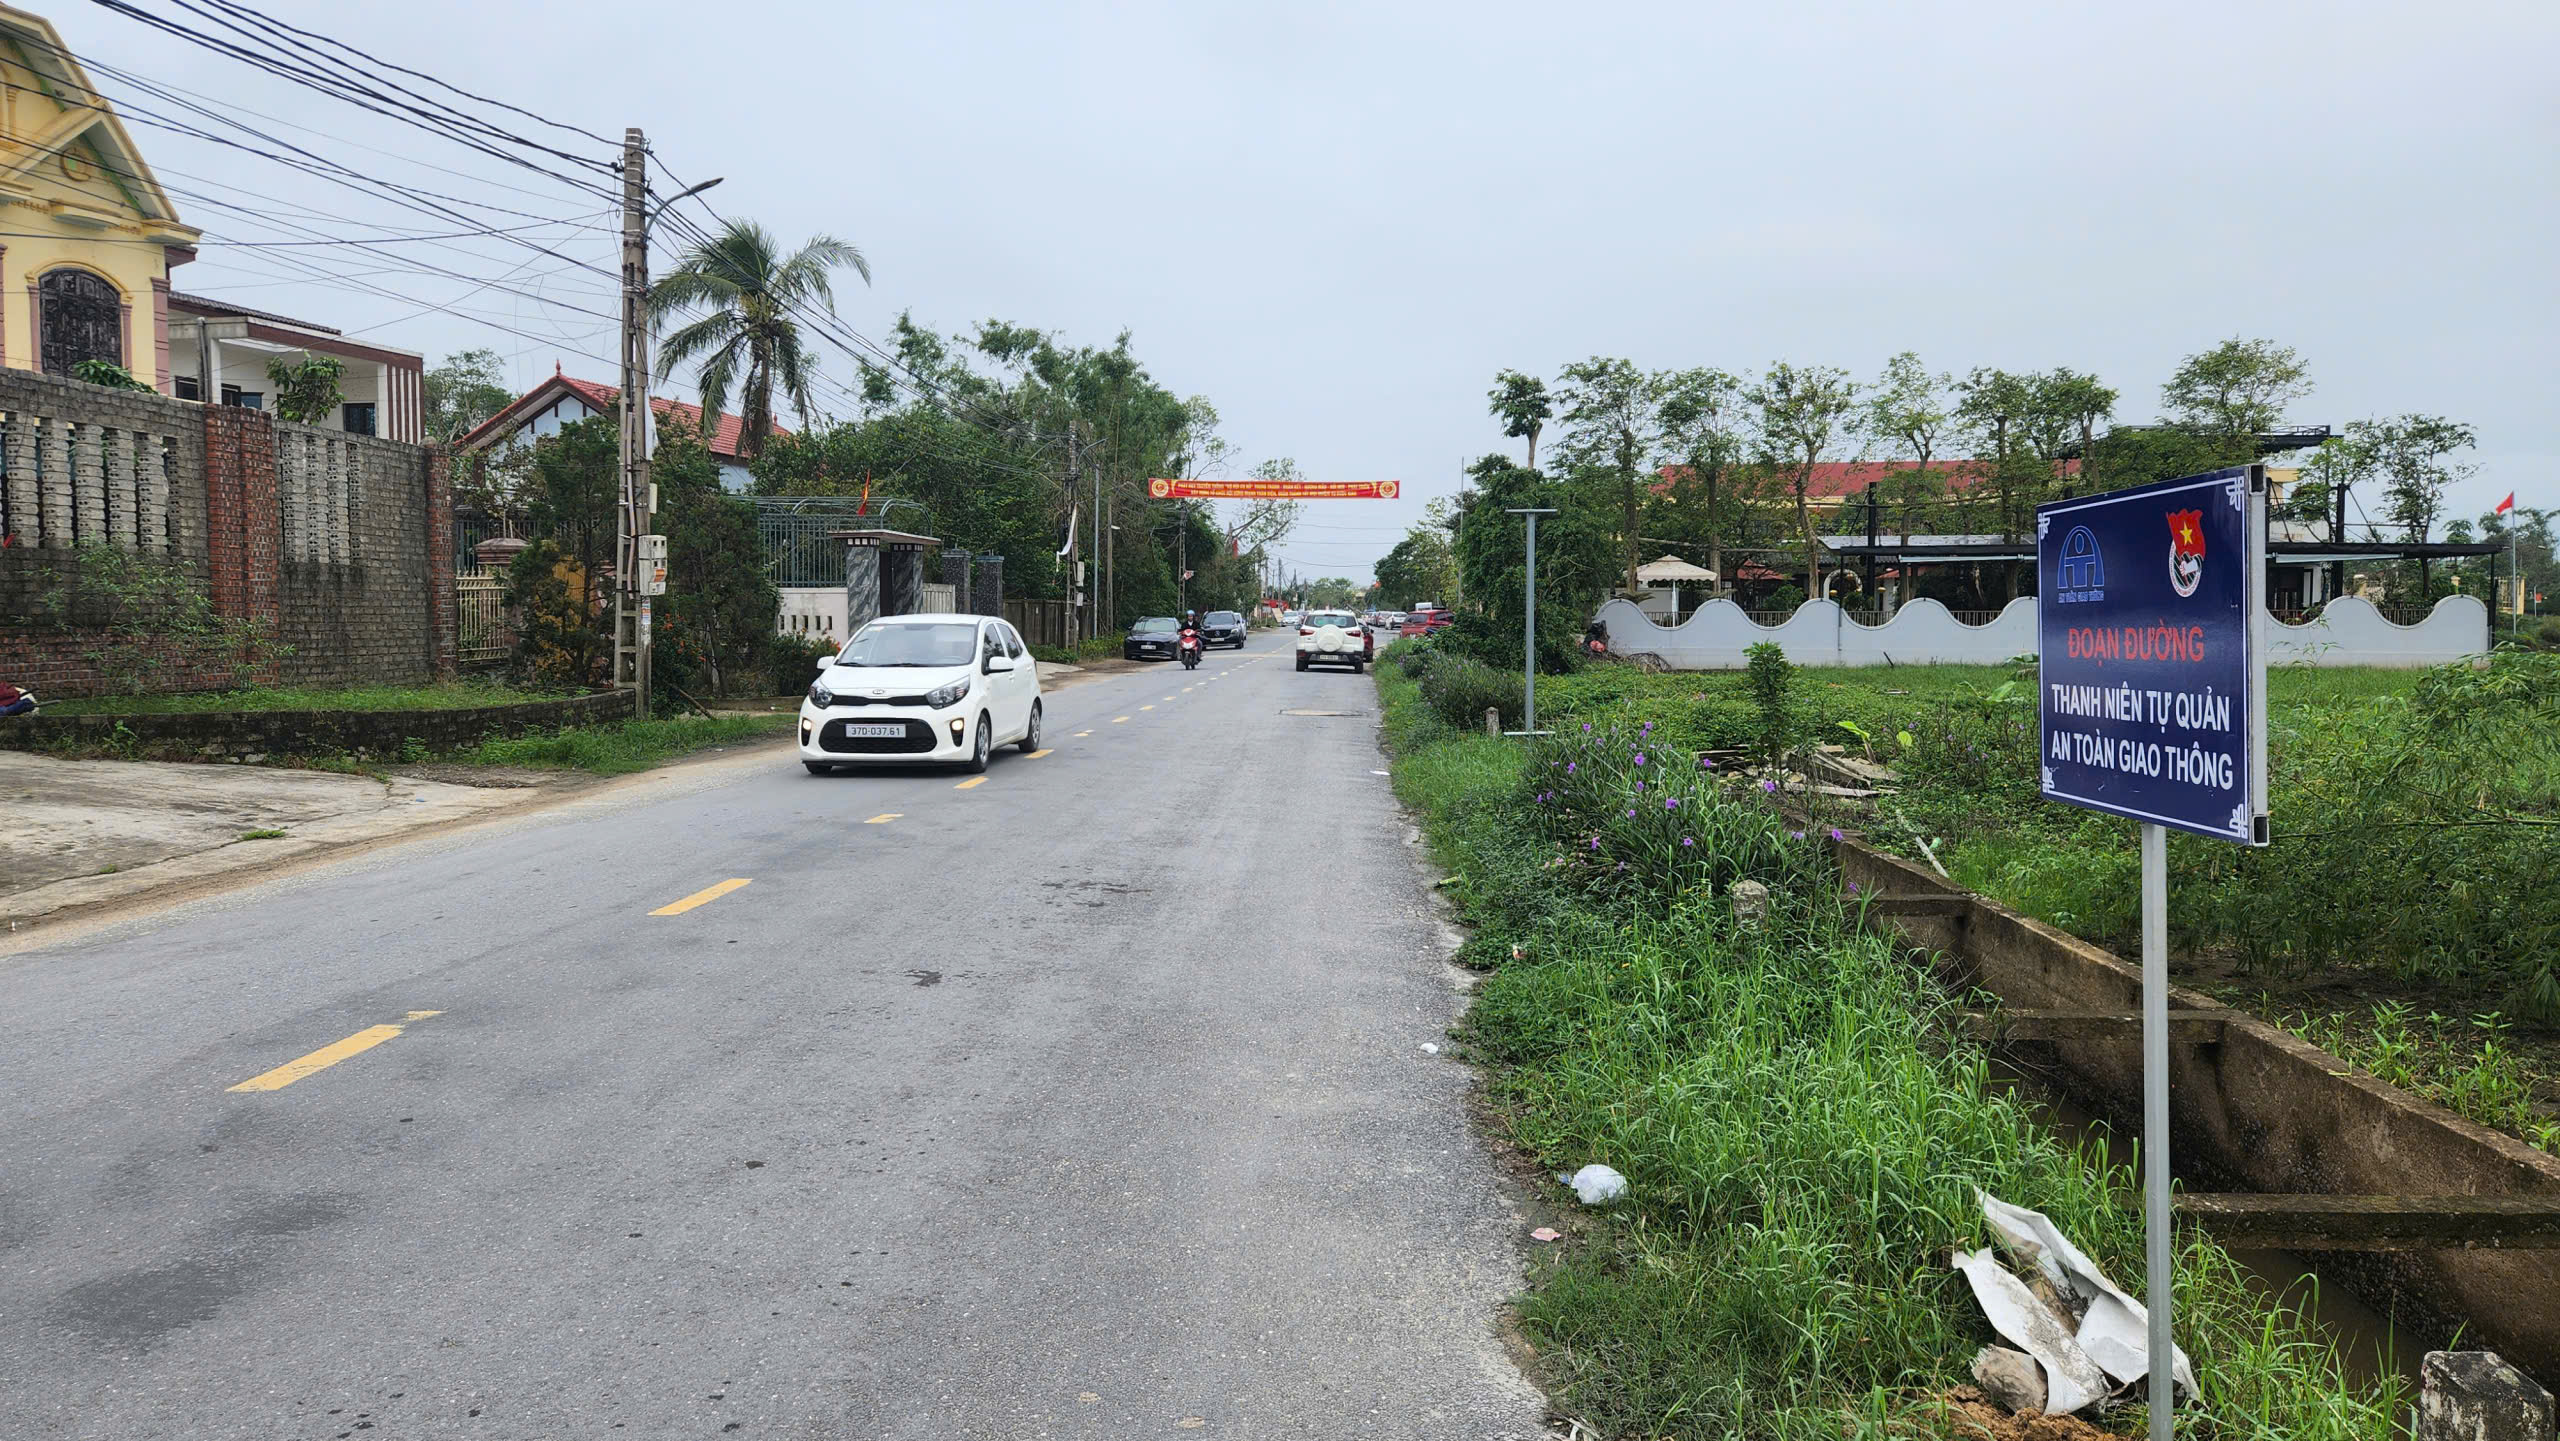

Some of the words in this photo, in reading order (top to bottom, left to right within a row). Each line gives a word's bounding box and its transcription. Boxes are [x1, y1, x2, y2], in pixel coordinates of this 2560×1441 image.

[2068, 627, 2120, 667] ĐOẠN
[2123, 616, 2205, 662] ĐƯỜNG
[2051, 684, 2101, 718] THANH
[2104, 680, 2142, 722] NIÊN
[2146, 690, 2172, 733] TỰ
[2175, 686, 2230, 732] QUẢN
[2051, 730, 2071, 761] AN
[2073, 728, 2115, 769] TOÀN
[2118, 739, 2161, 777] GIAO
[2164, 741, 2233, 790] THÔNG
